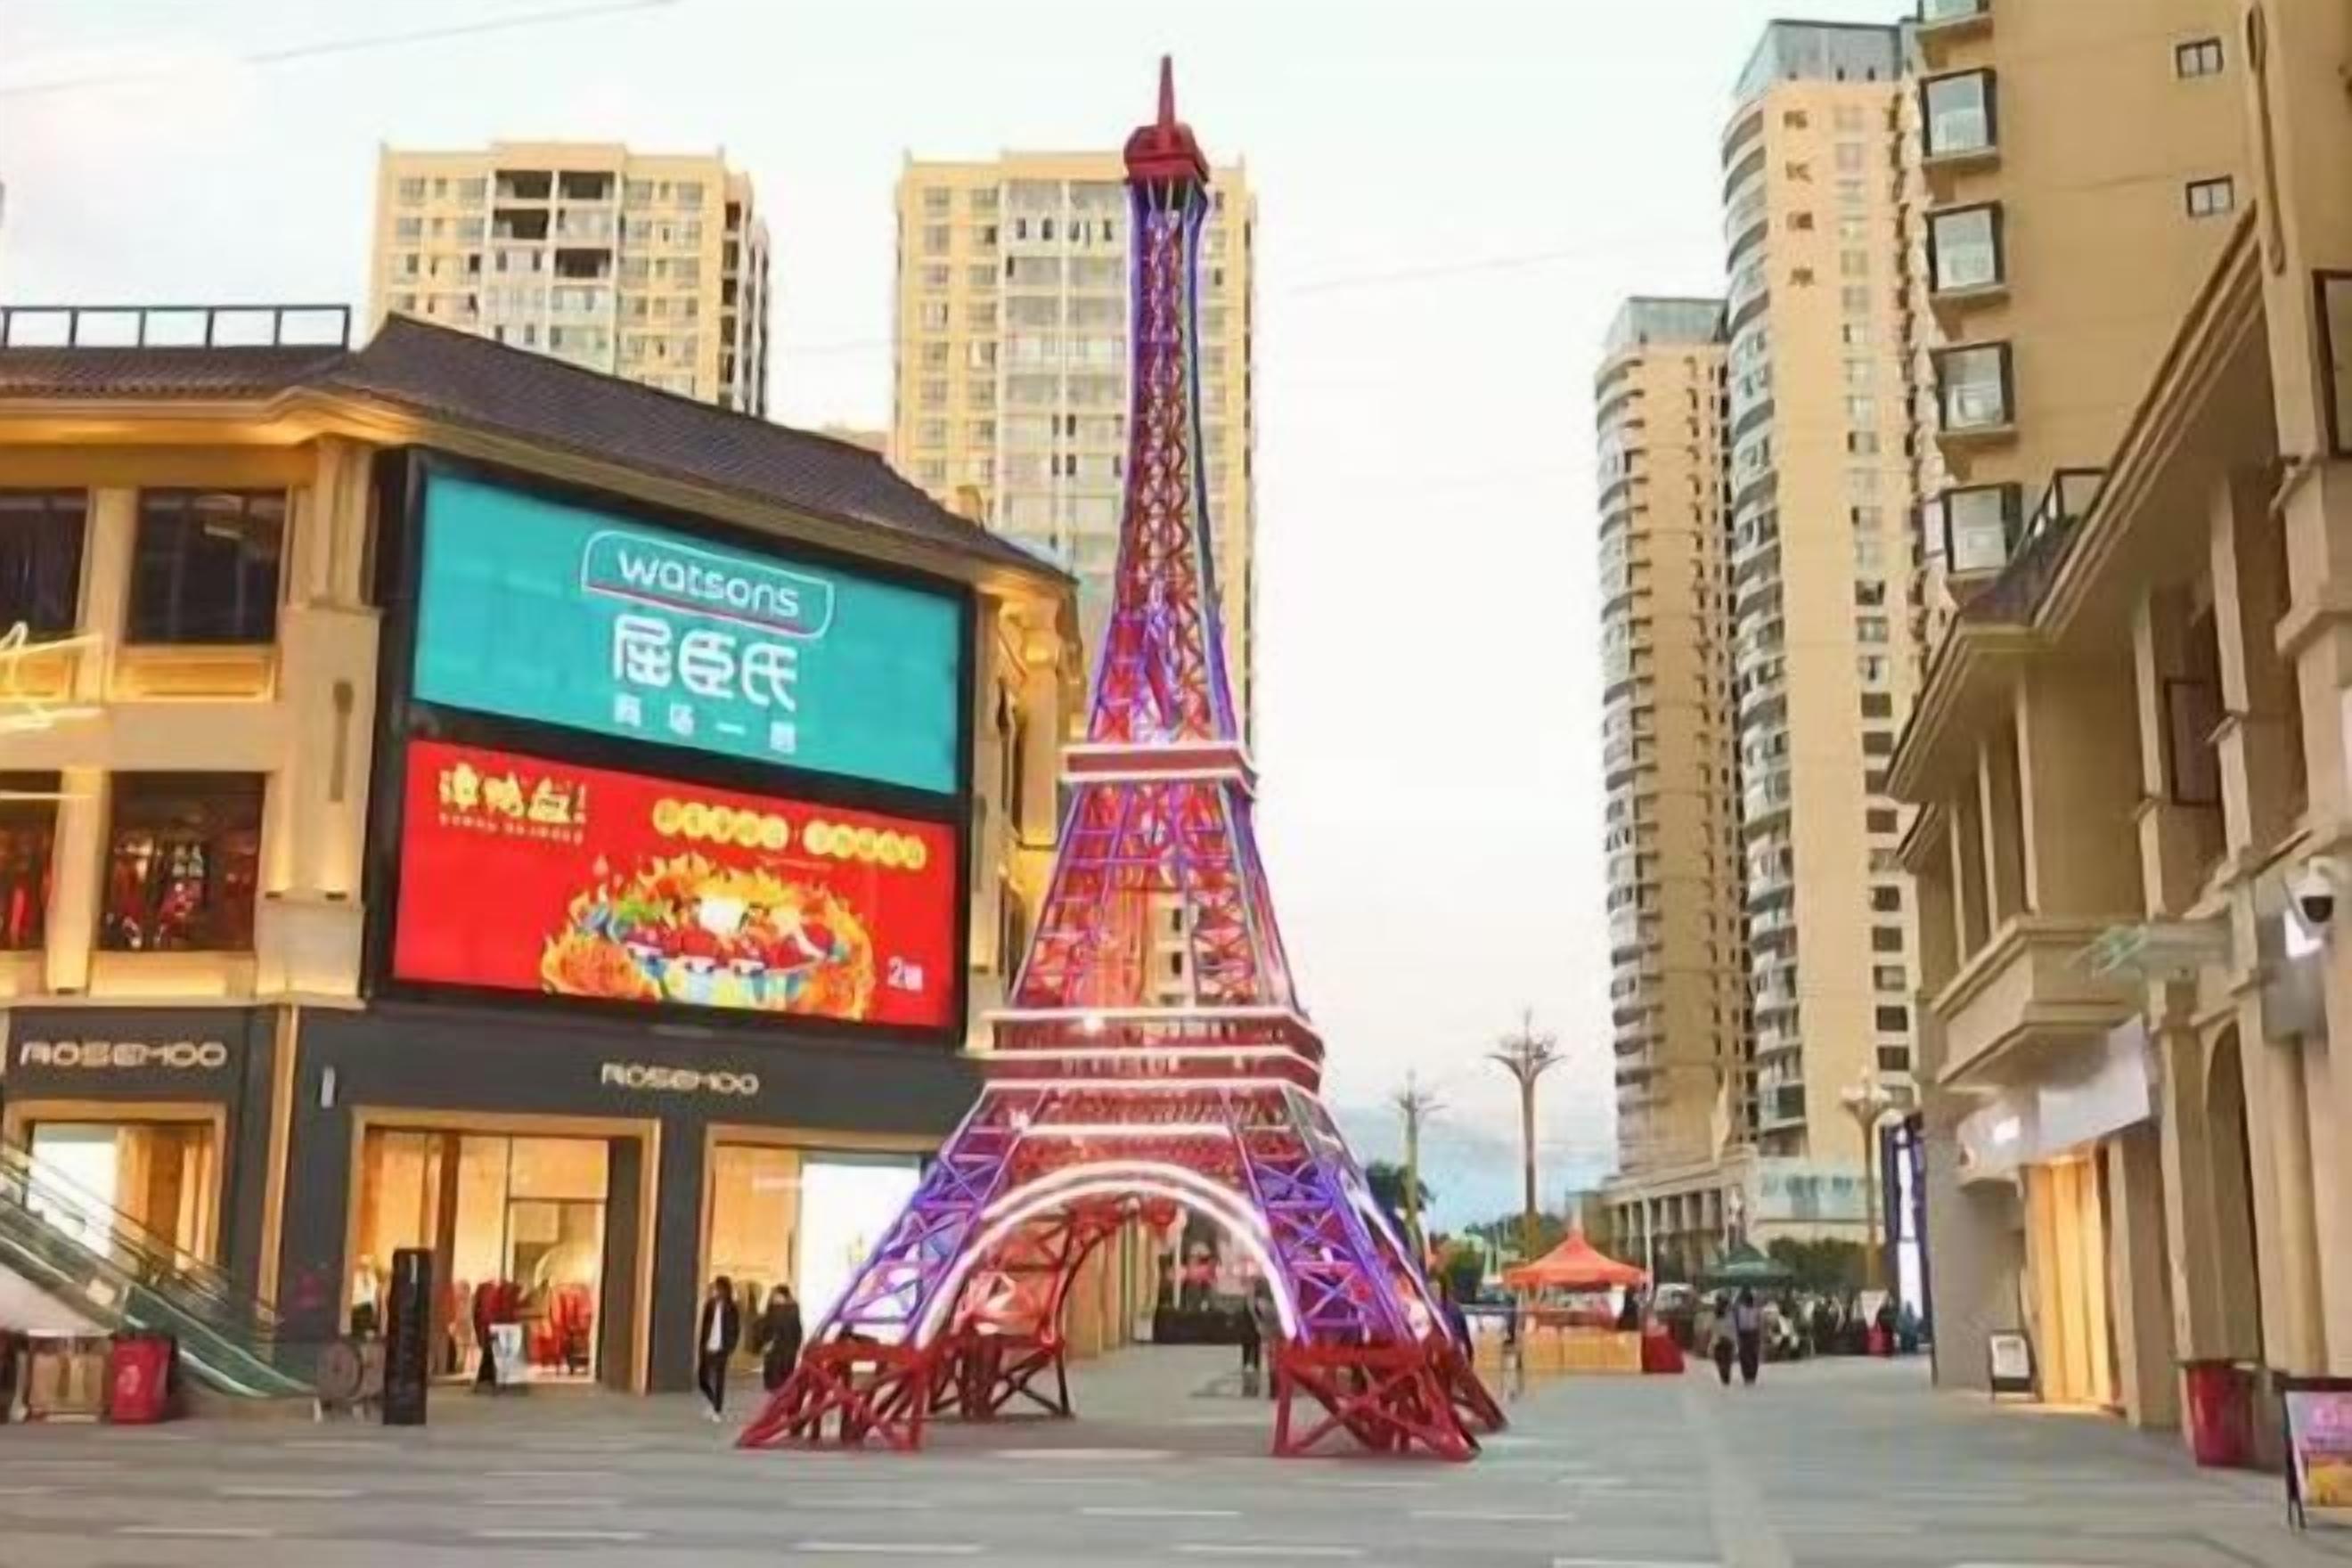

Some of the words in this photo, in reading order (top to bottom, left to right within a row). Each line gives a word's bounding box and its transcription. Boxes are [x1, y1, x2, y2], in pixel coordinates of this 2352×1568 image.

[617, 548, 800, 619] watsons
[613, 613, 799, 713] 屈臣氏
